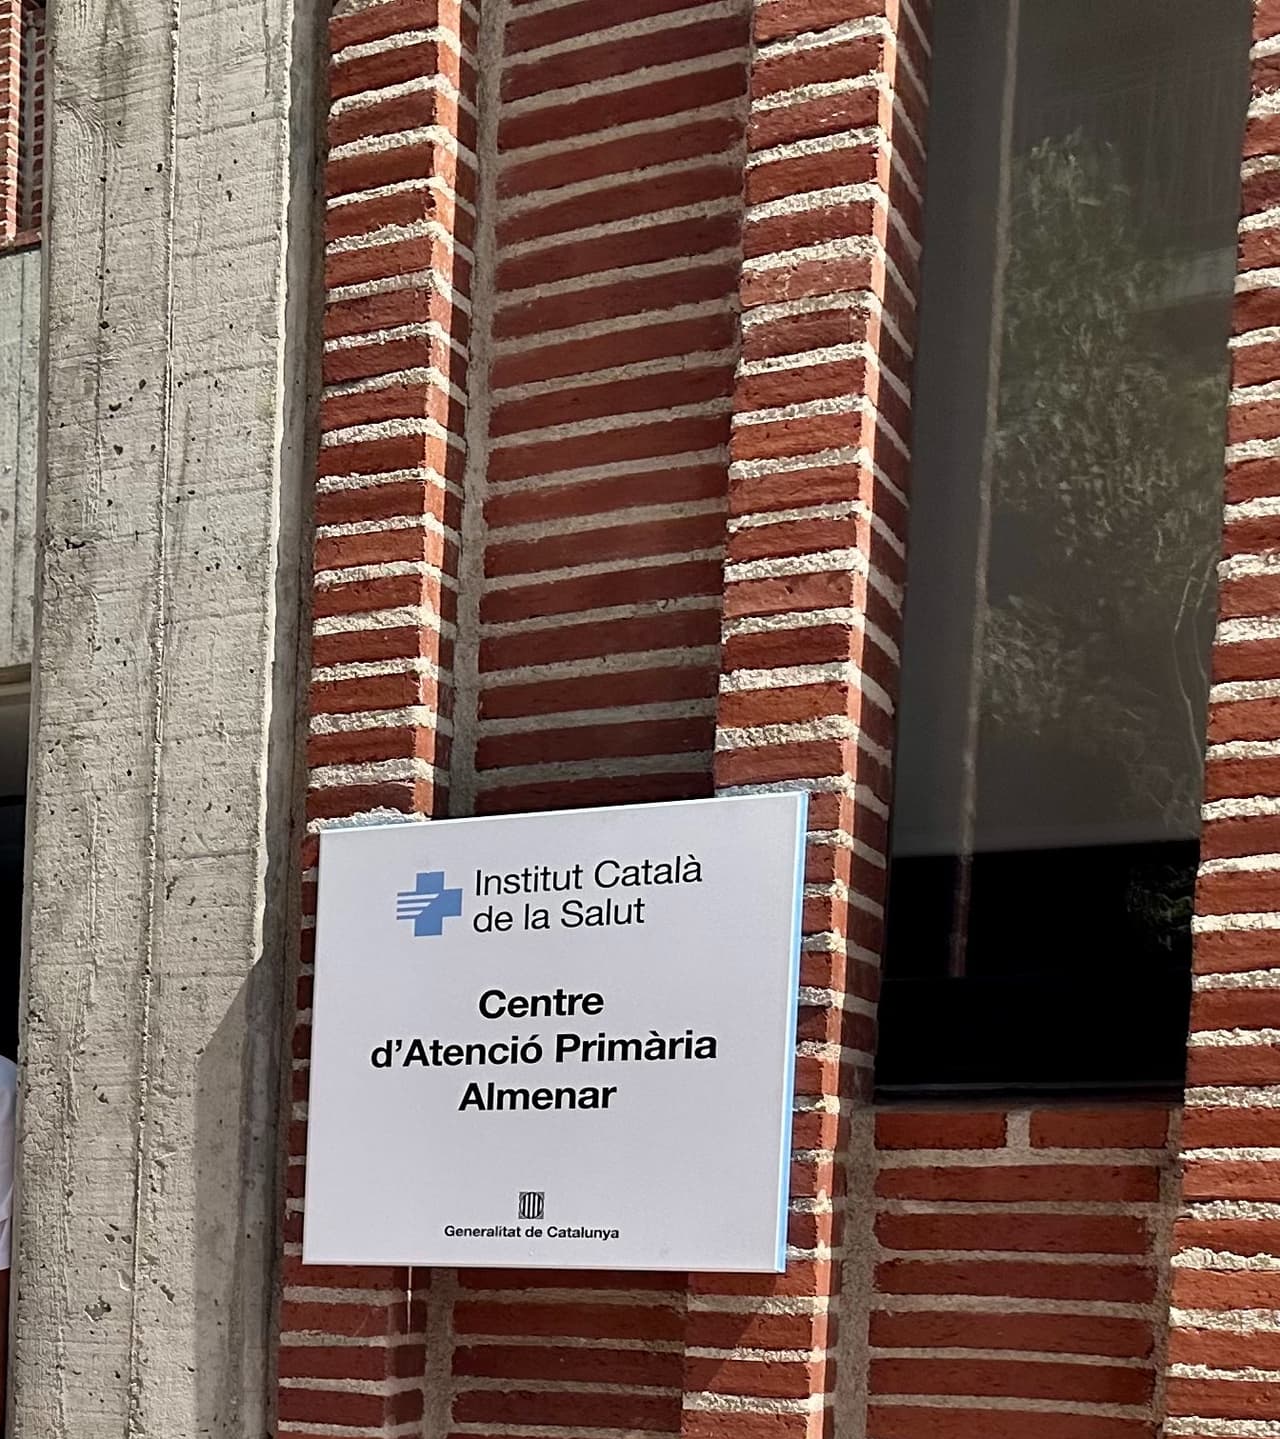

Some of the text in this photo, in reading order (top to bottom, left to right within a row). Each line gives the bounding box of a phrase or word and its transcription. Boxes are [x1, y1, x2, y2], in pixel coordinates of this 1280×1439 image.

[475, 854, 703, 896] Institut Català
[473, 897, 646, 933] de la Salut
[478, 988, 605, 1020] Centre
[370, 1030, 718, 1069] d’Atenció Primària
[458, 1081, 618, 1112] Almenar
[444, 1225, 620, 1241] Generalitat de Catalunya
